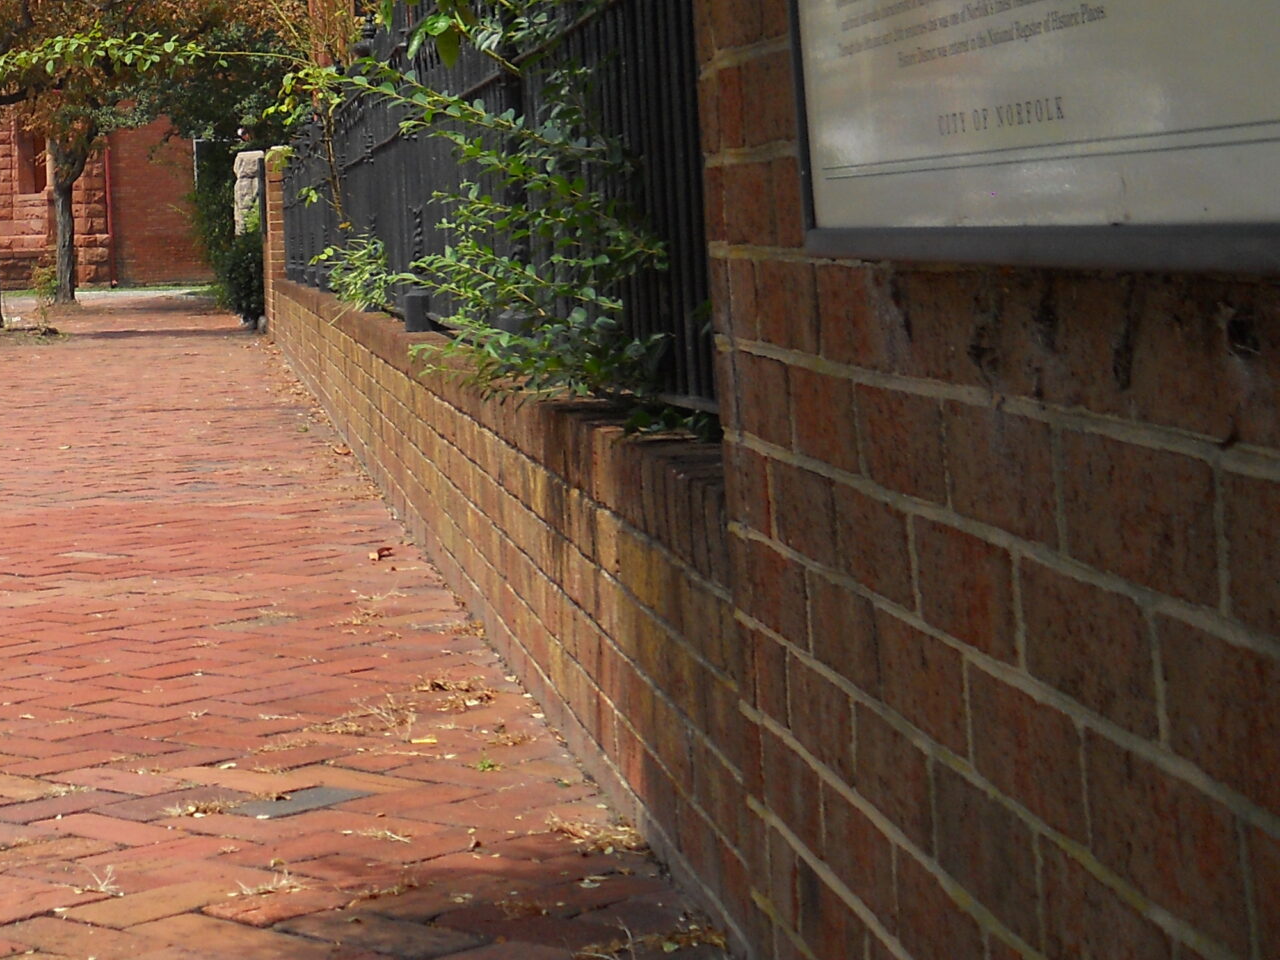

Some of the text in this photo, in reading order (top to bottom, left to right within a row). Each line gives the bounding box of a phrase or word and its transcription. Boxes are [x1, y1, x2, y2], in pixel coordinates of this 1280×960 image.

[969, 32, 976, 49] in
[975, 29, 986, 47] the
[986, 20, 1014, 45] National
[1014, 17, 1043, 41] Register
[1042, 11, 1051, 31] of
[1050, 5, 1081, 29] Historic
[937, 95, 1065, 136] CITY OF NORFOLK
